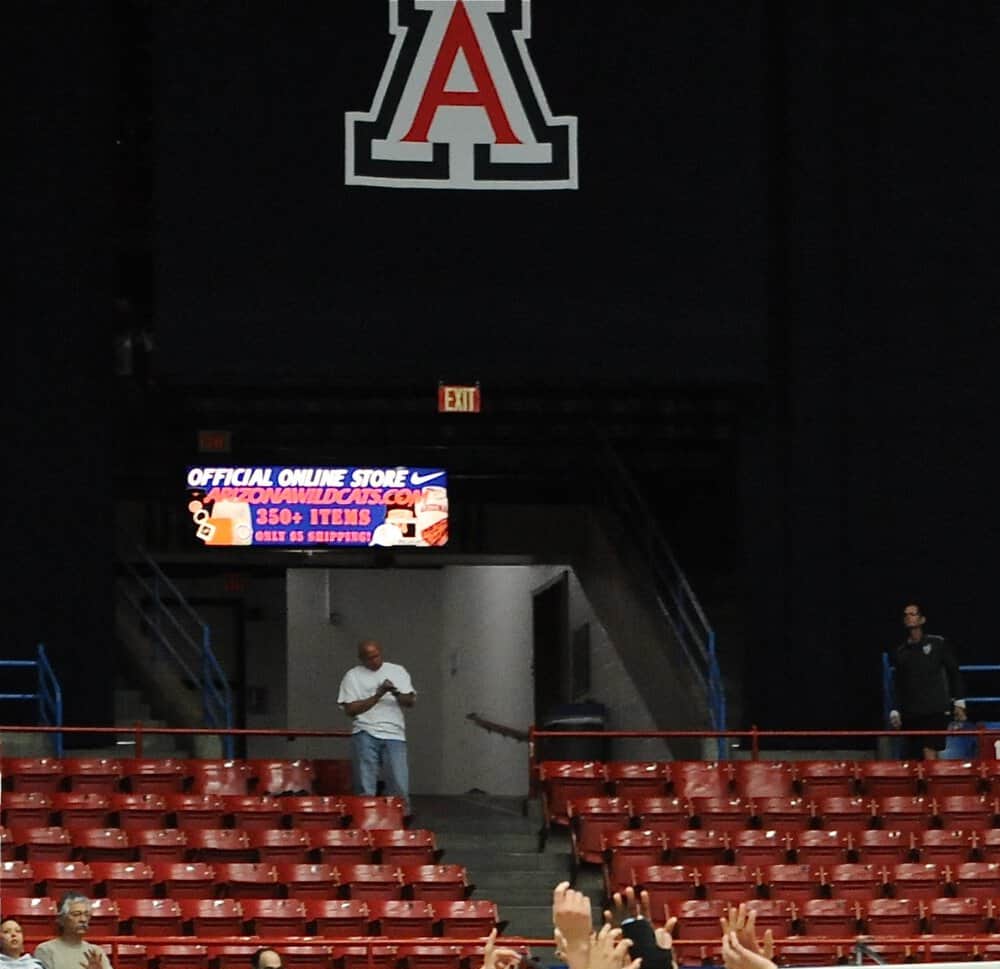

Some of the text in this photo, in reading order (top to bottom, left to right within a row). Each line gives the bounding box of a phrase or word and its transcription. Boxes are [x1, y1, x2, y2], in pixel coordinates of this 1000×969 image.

[345, 0, 579, 189] A
[444, 387, 475, 411] EXIT
[187, 468, 409, 488] OFFICIAL ONLINE STORE
[256, 508, 371, 525] 350+ ITEMS
